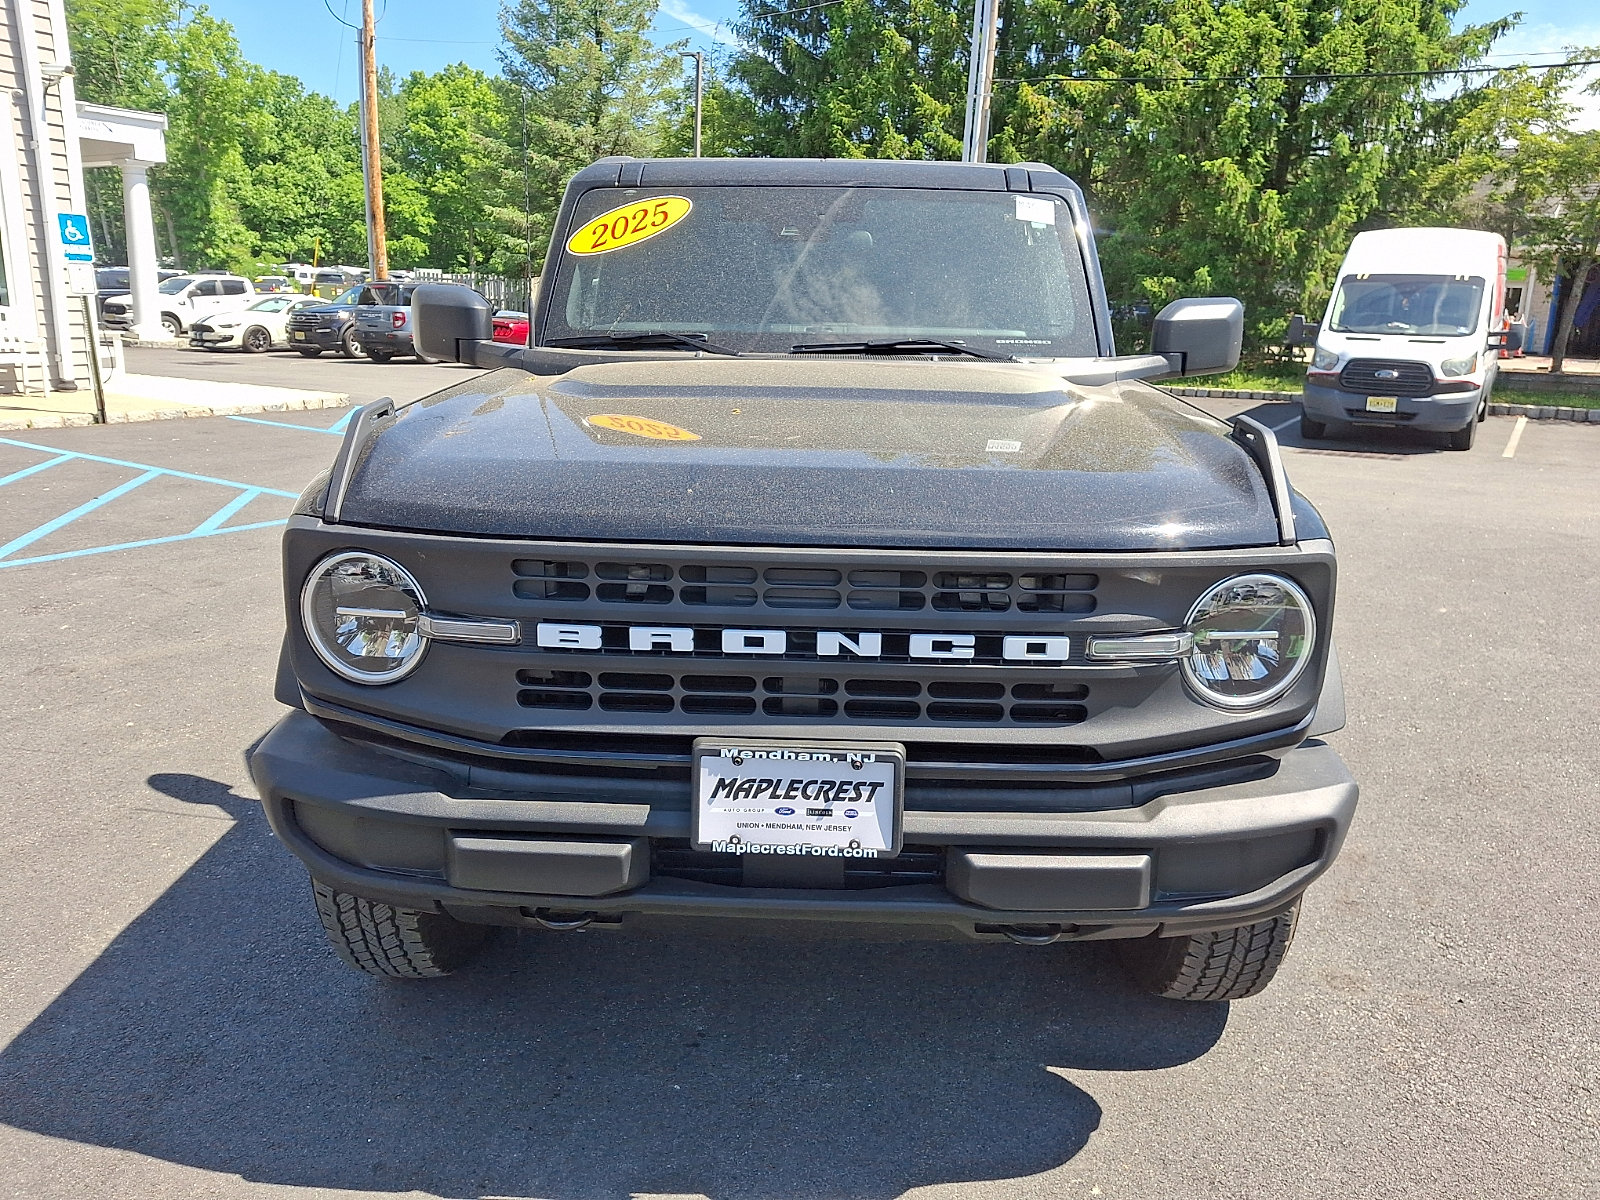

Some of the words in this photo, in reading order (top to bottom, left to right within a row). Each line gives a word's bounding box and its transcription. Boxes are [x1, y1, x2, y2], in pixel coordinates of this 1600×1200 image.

[591, 201, 669, 250] 2025
[535, 621, 1072, 661] BRONCO
[720, 748, 839, 764] Mendham,
[846, 753, 876, 763] NJ
[709, 777, 885, 804] MAPLECREST
[765, 822, 805, 831] MENDHAM,
[711, 840, 878, 859] MaplecrestFord.com
